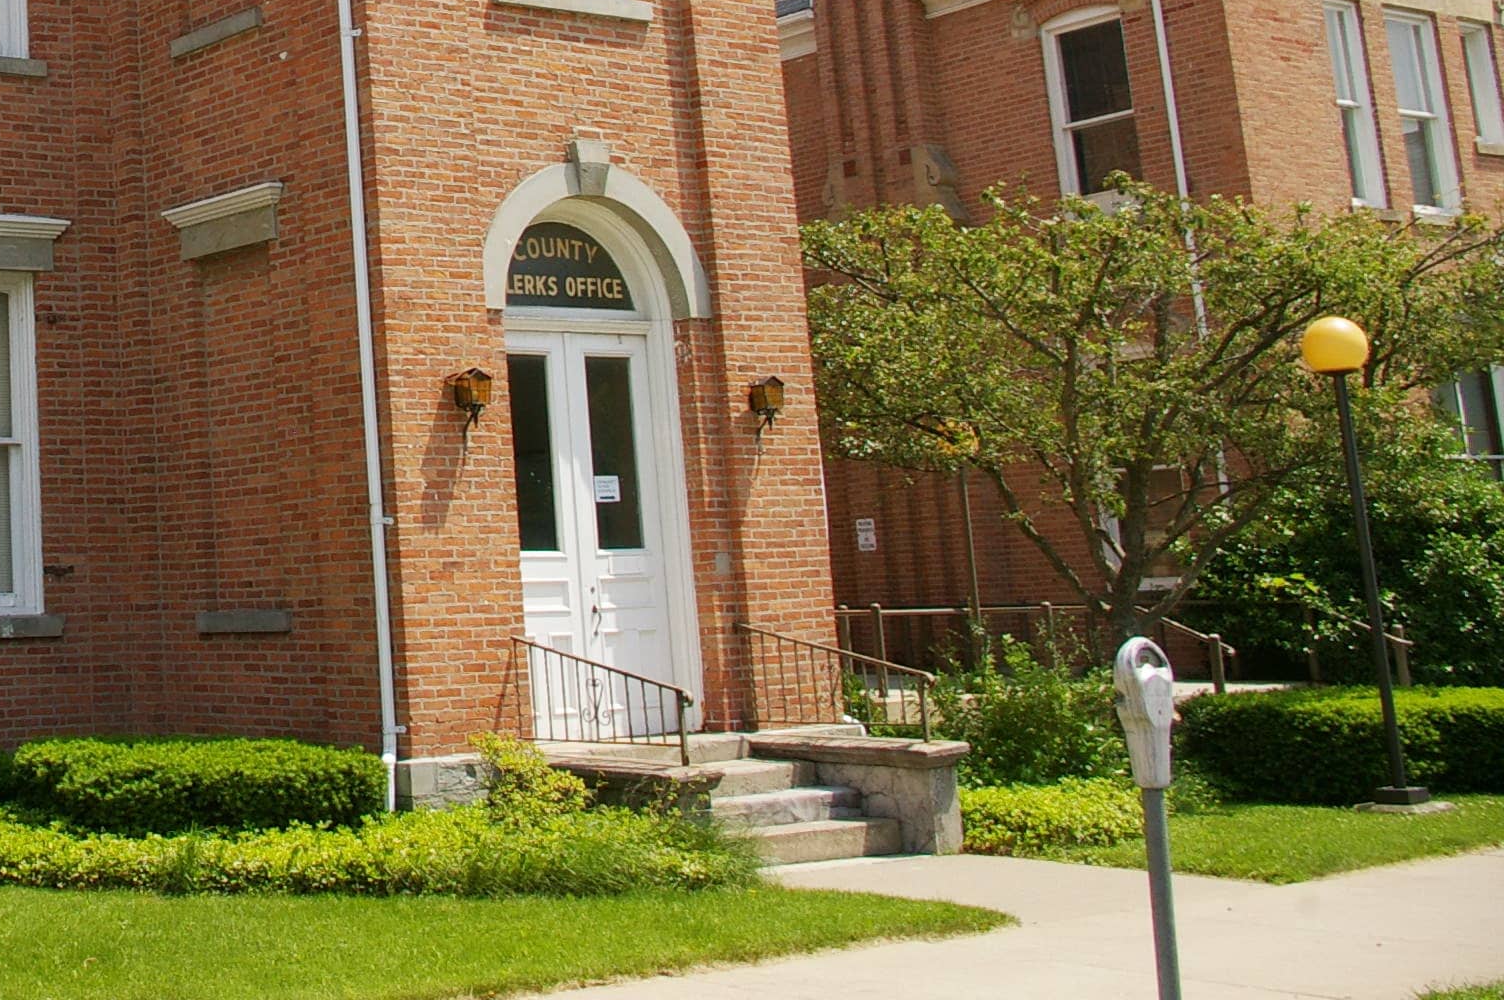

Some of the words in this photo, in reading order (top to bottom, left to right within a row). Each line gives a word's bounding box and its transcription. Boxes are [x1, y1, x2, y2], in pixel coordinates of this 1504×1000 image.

[513, 237, 598, 264] COUNTY
[505, 274, 558, 297] LERKS
[565, 277, 624, 299] OFFICE
